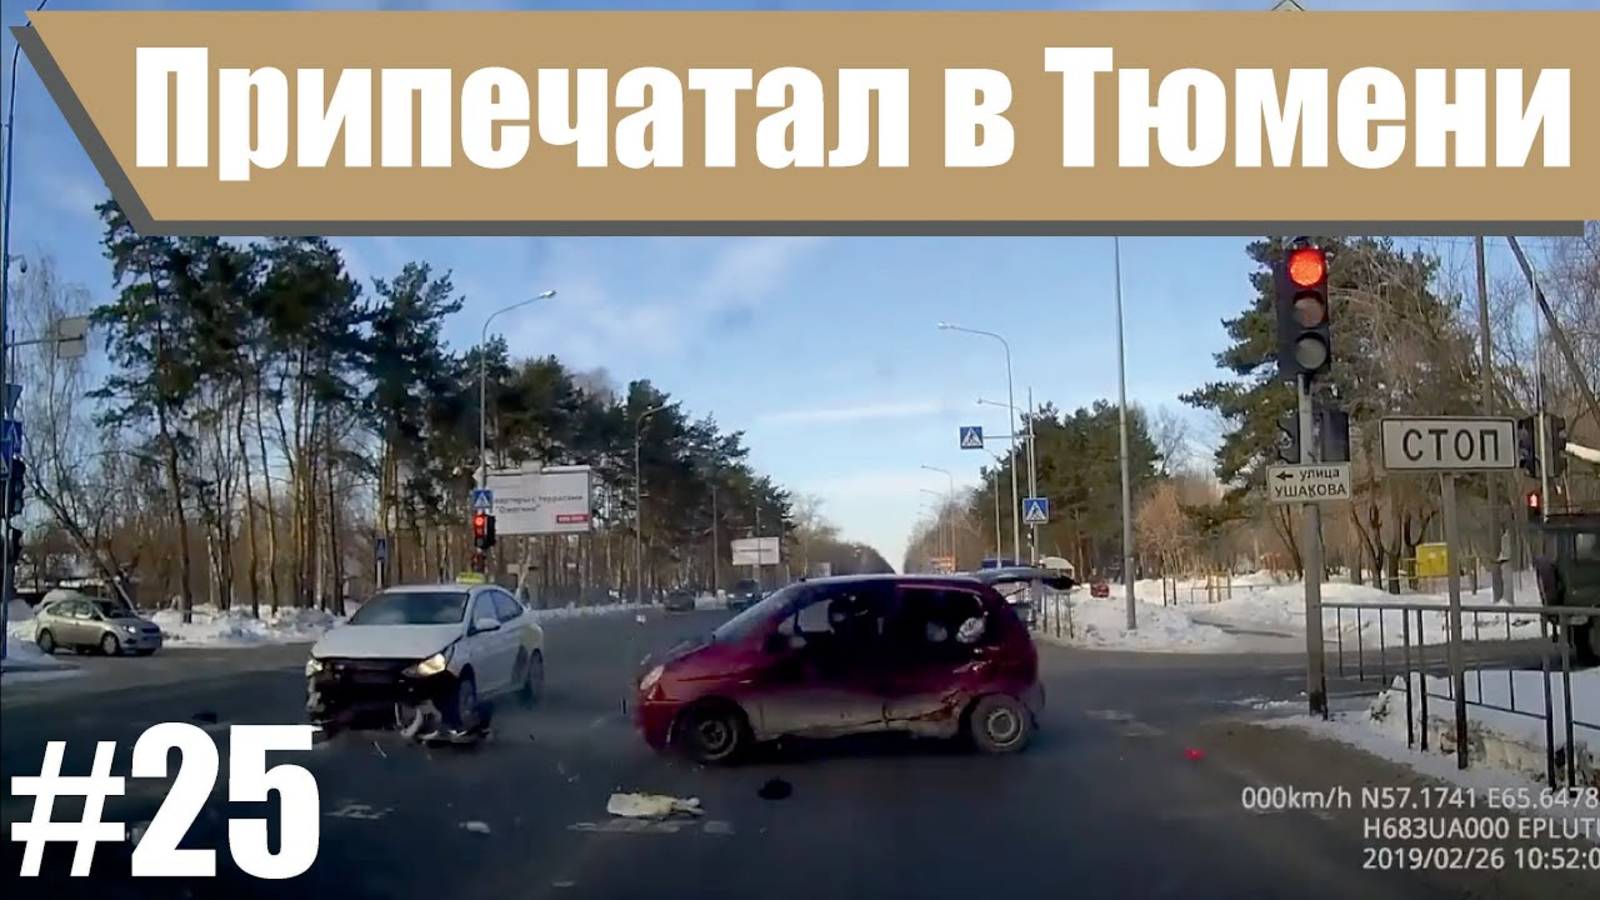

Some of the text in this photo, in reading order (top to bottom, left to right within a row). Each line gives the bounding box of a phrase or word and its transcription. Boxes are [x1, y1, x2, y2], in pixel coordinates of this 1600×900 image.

[1402, 428, 1499, 461] СТОП
[1300, 468, 1340, 481] улица
[1275, 483, 1346, 498] УШАКОВА
